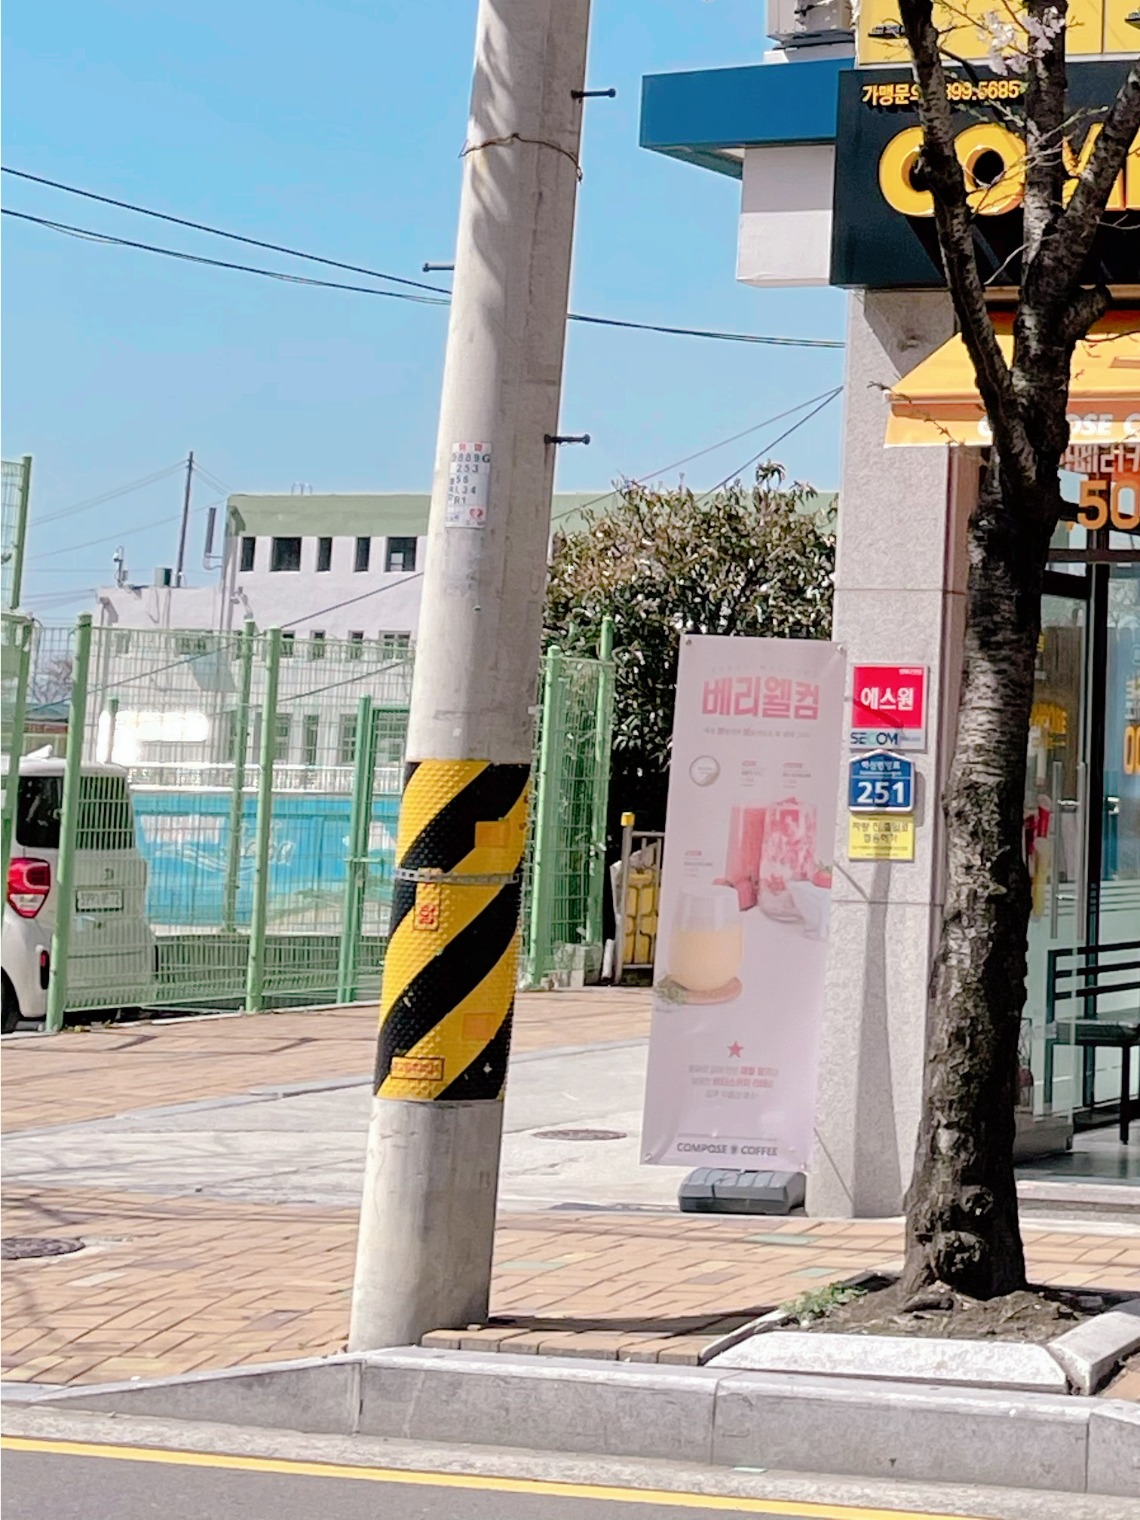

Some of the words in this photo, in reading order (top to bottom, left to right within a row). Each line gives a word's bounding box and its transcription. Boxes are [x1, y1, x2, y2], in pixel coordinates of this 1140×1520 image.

[861, 687, 914, 711] 에스원
[850, 732, 899, 746] SECOM
[857, 781, 905, 804] 251
[676, 1142, 728, 1154] COMPOSE
[740, 1145, 778, 1156] COFFEE
